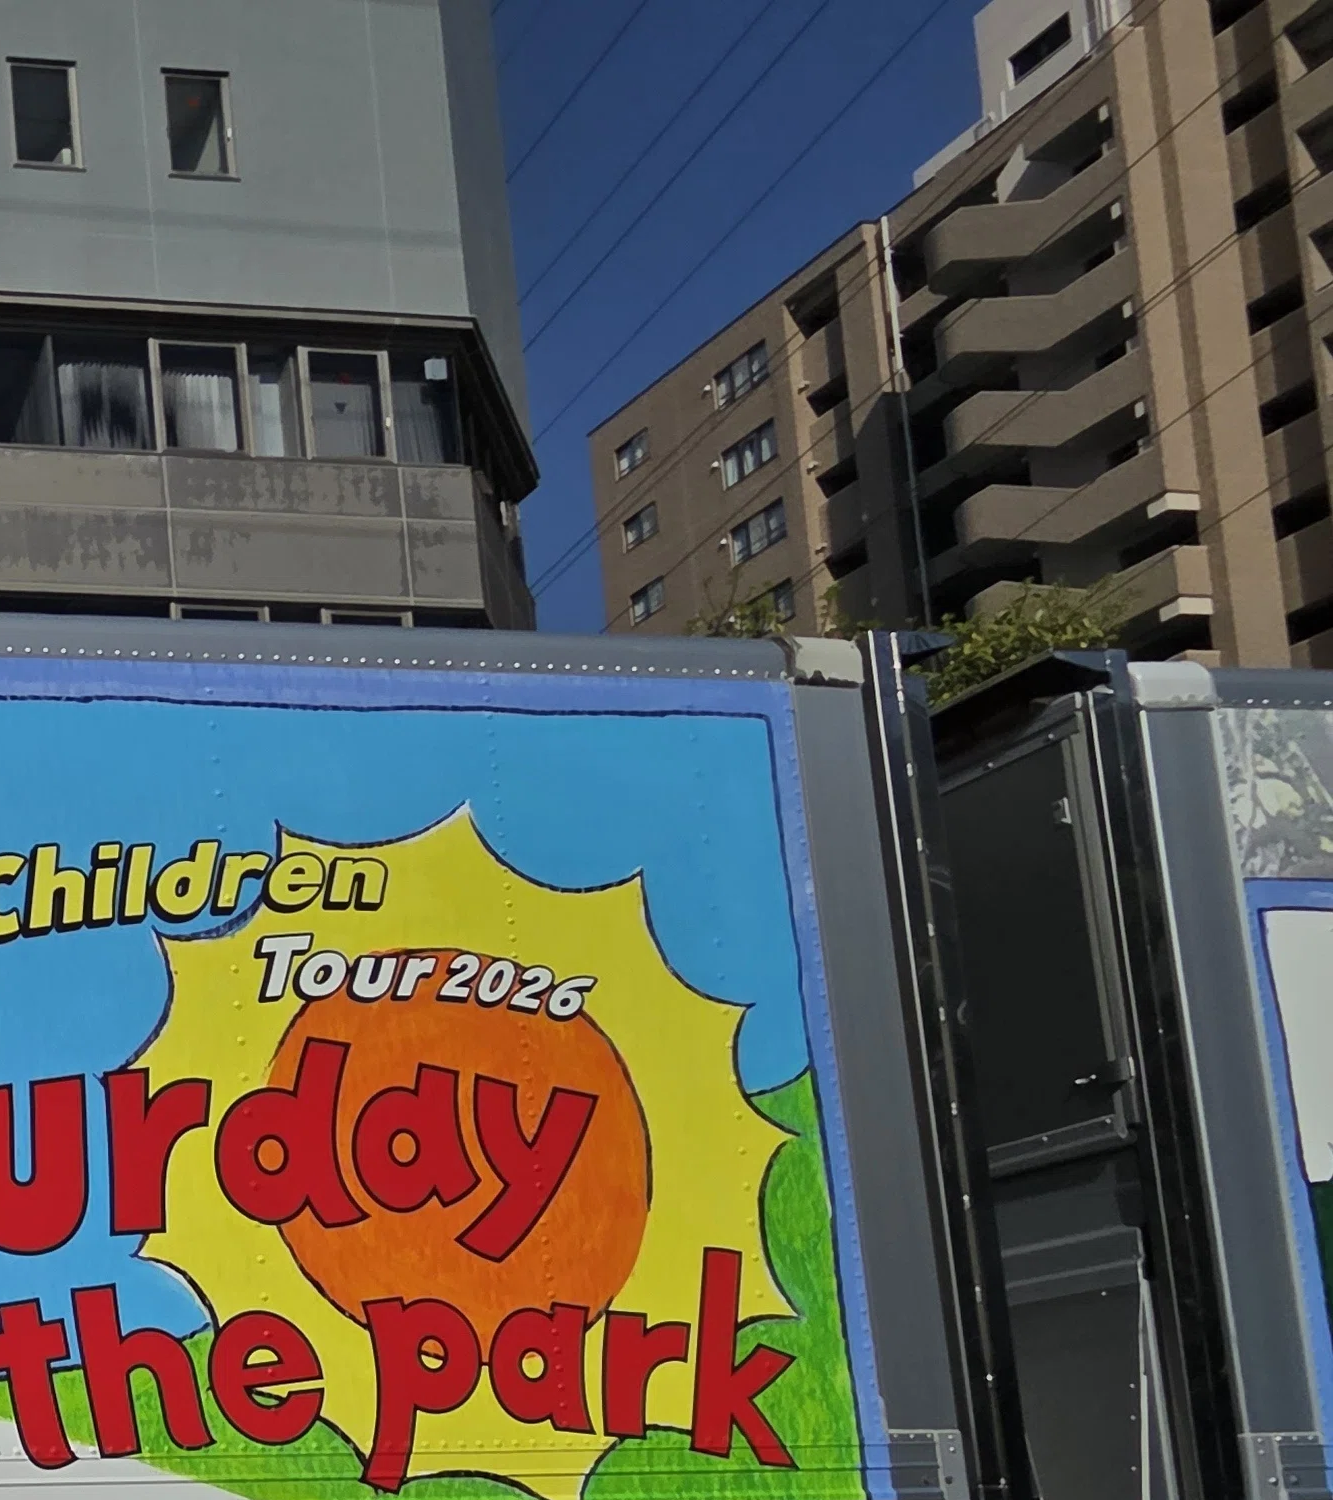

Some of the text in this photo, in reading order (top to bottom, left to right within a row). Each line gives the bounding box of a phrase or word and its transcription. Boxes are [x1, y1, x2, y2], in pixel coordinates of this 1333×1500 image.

[253, 932, 599, 1023] Tour 2026
[359, 1246, 799, 1494] park
